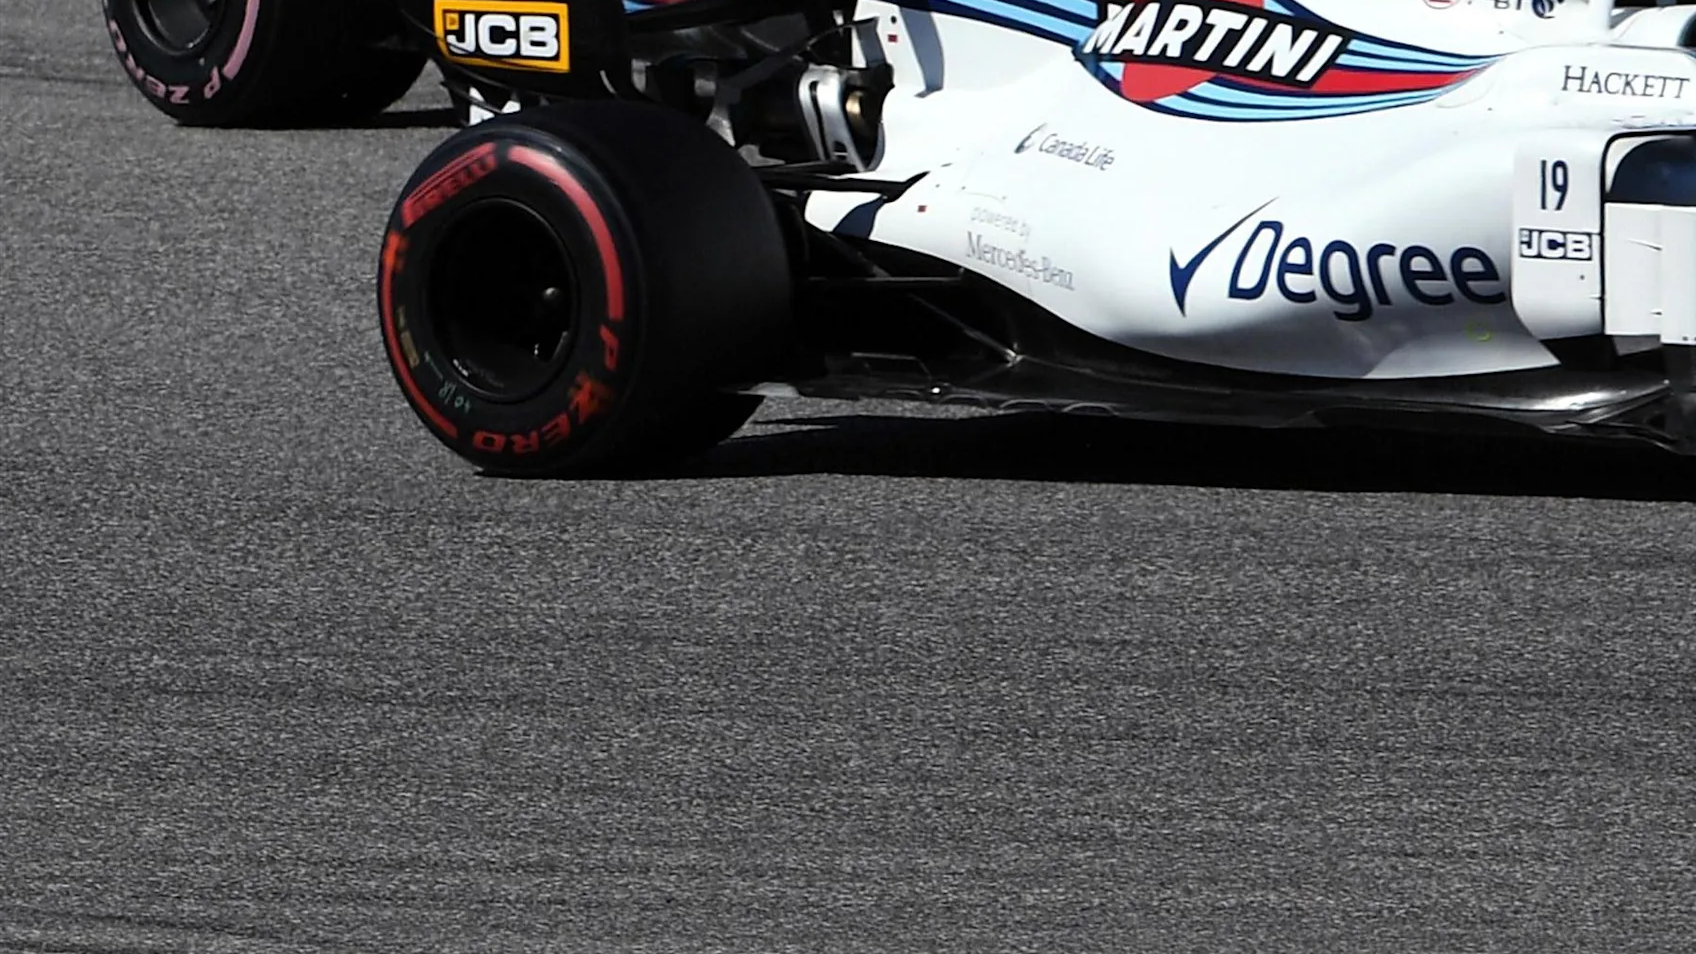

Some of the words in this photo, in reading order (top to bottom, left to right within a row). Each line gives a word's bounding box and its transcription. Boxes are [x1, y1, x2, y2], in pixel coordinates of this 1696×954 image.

[445, 13, 561, 59] JCB
[1083, 1, 1343, 83] MARTINI
[1561, 64, 1691, 99] HACKETT
[1038, 133, 1089, 163] Canada
[1084, 145, 1116, 171] Life
[1540, 158, 1569, 211] 19
[966, 230, 1076, 292] Mercedes-Benz
[1523, 232, 1593, 259] JCB
[1228, 219, 1507, 322] Degree
